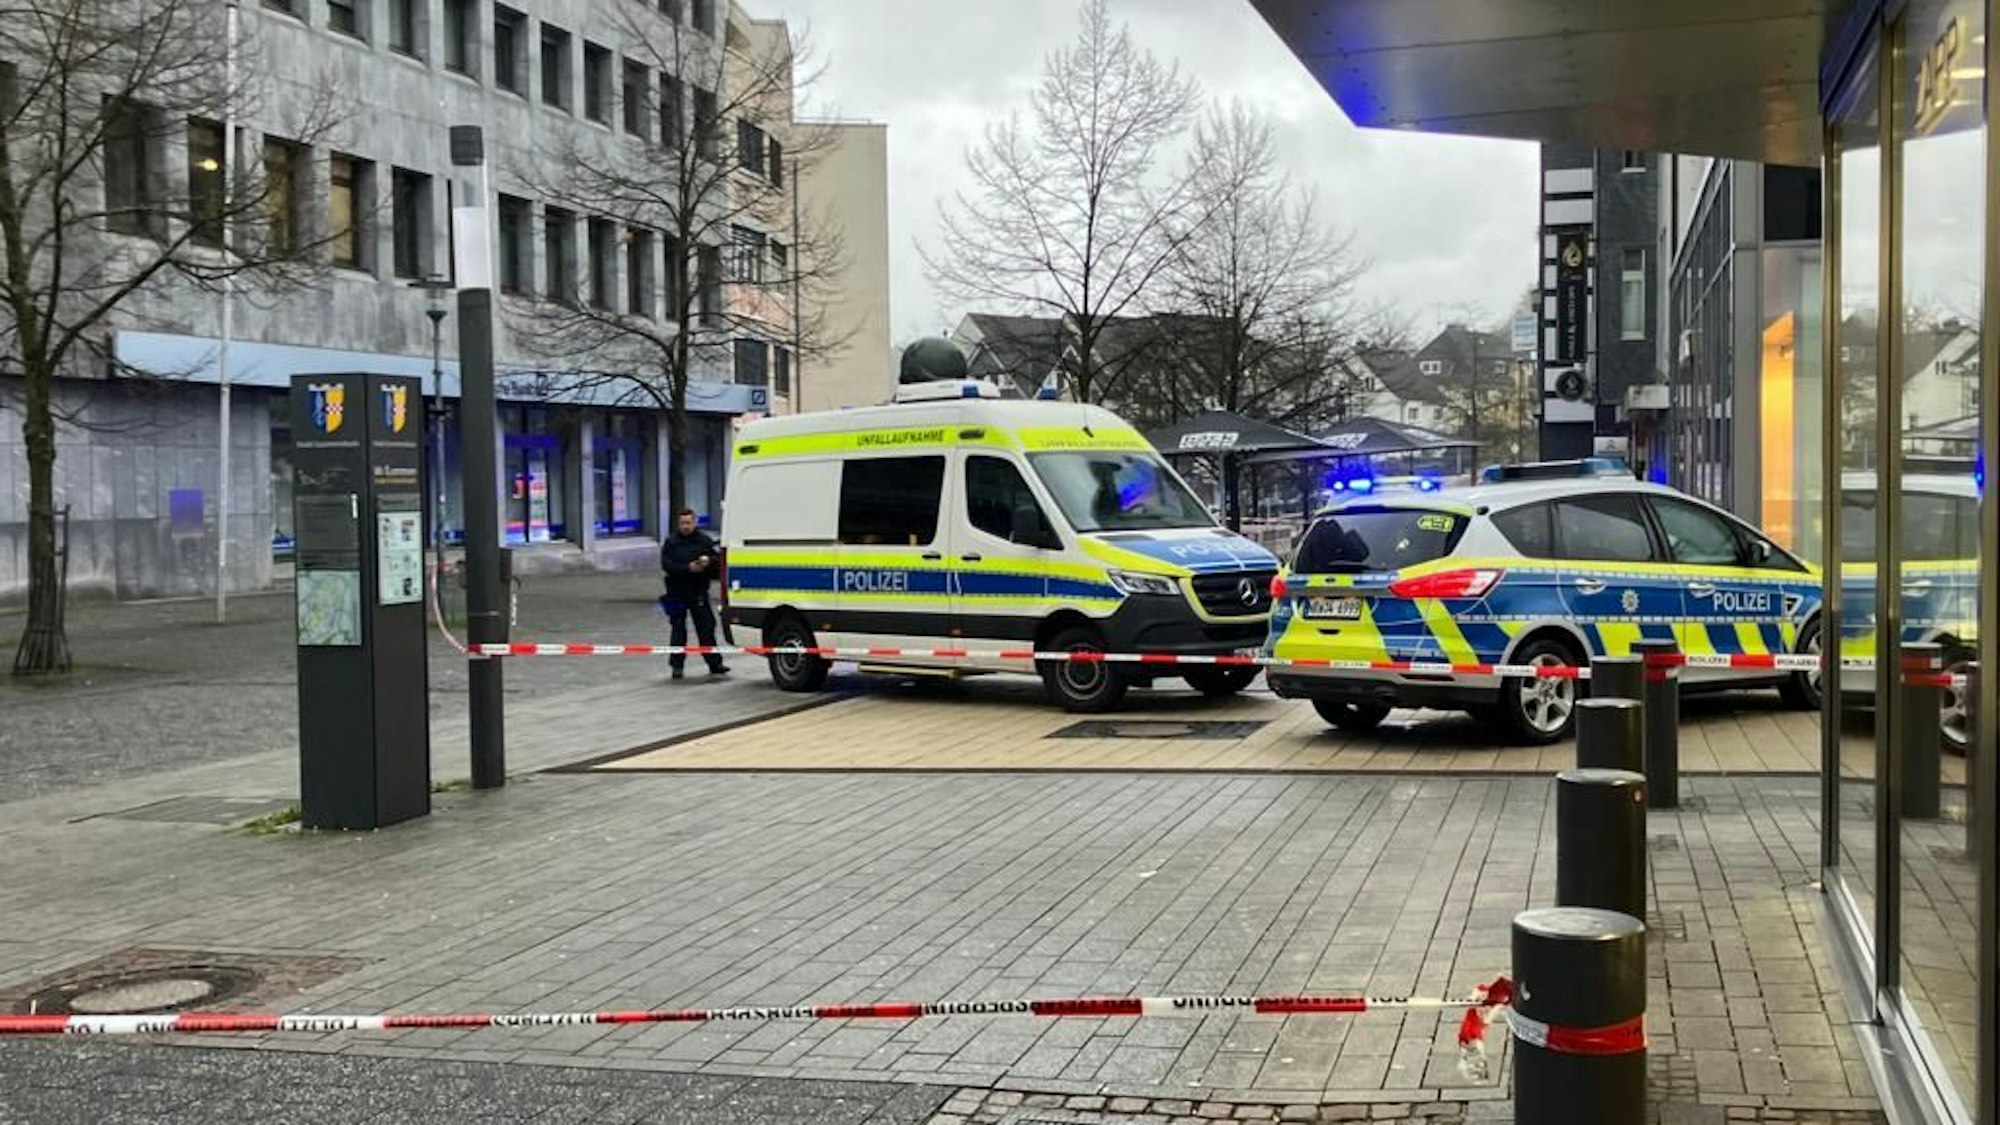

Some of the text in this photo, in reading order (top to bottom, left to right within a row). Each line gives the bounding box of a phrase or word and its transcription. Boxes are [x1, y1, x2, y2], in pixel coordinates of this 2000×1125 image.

[857, 429, 944, 446] UNFALLAUFNAHME
[844, 570, 908, 591] POLIZEI
[1713, 592, 1771, 611] POLIZEI
